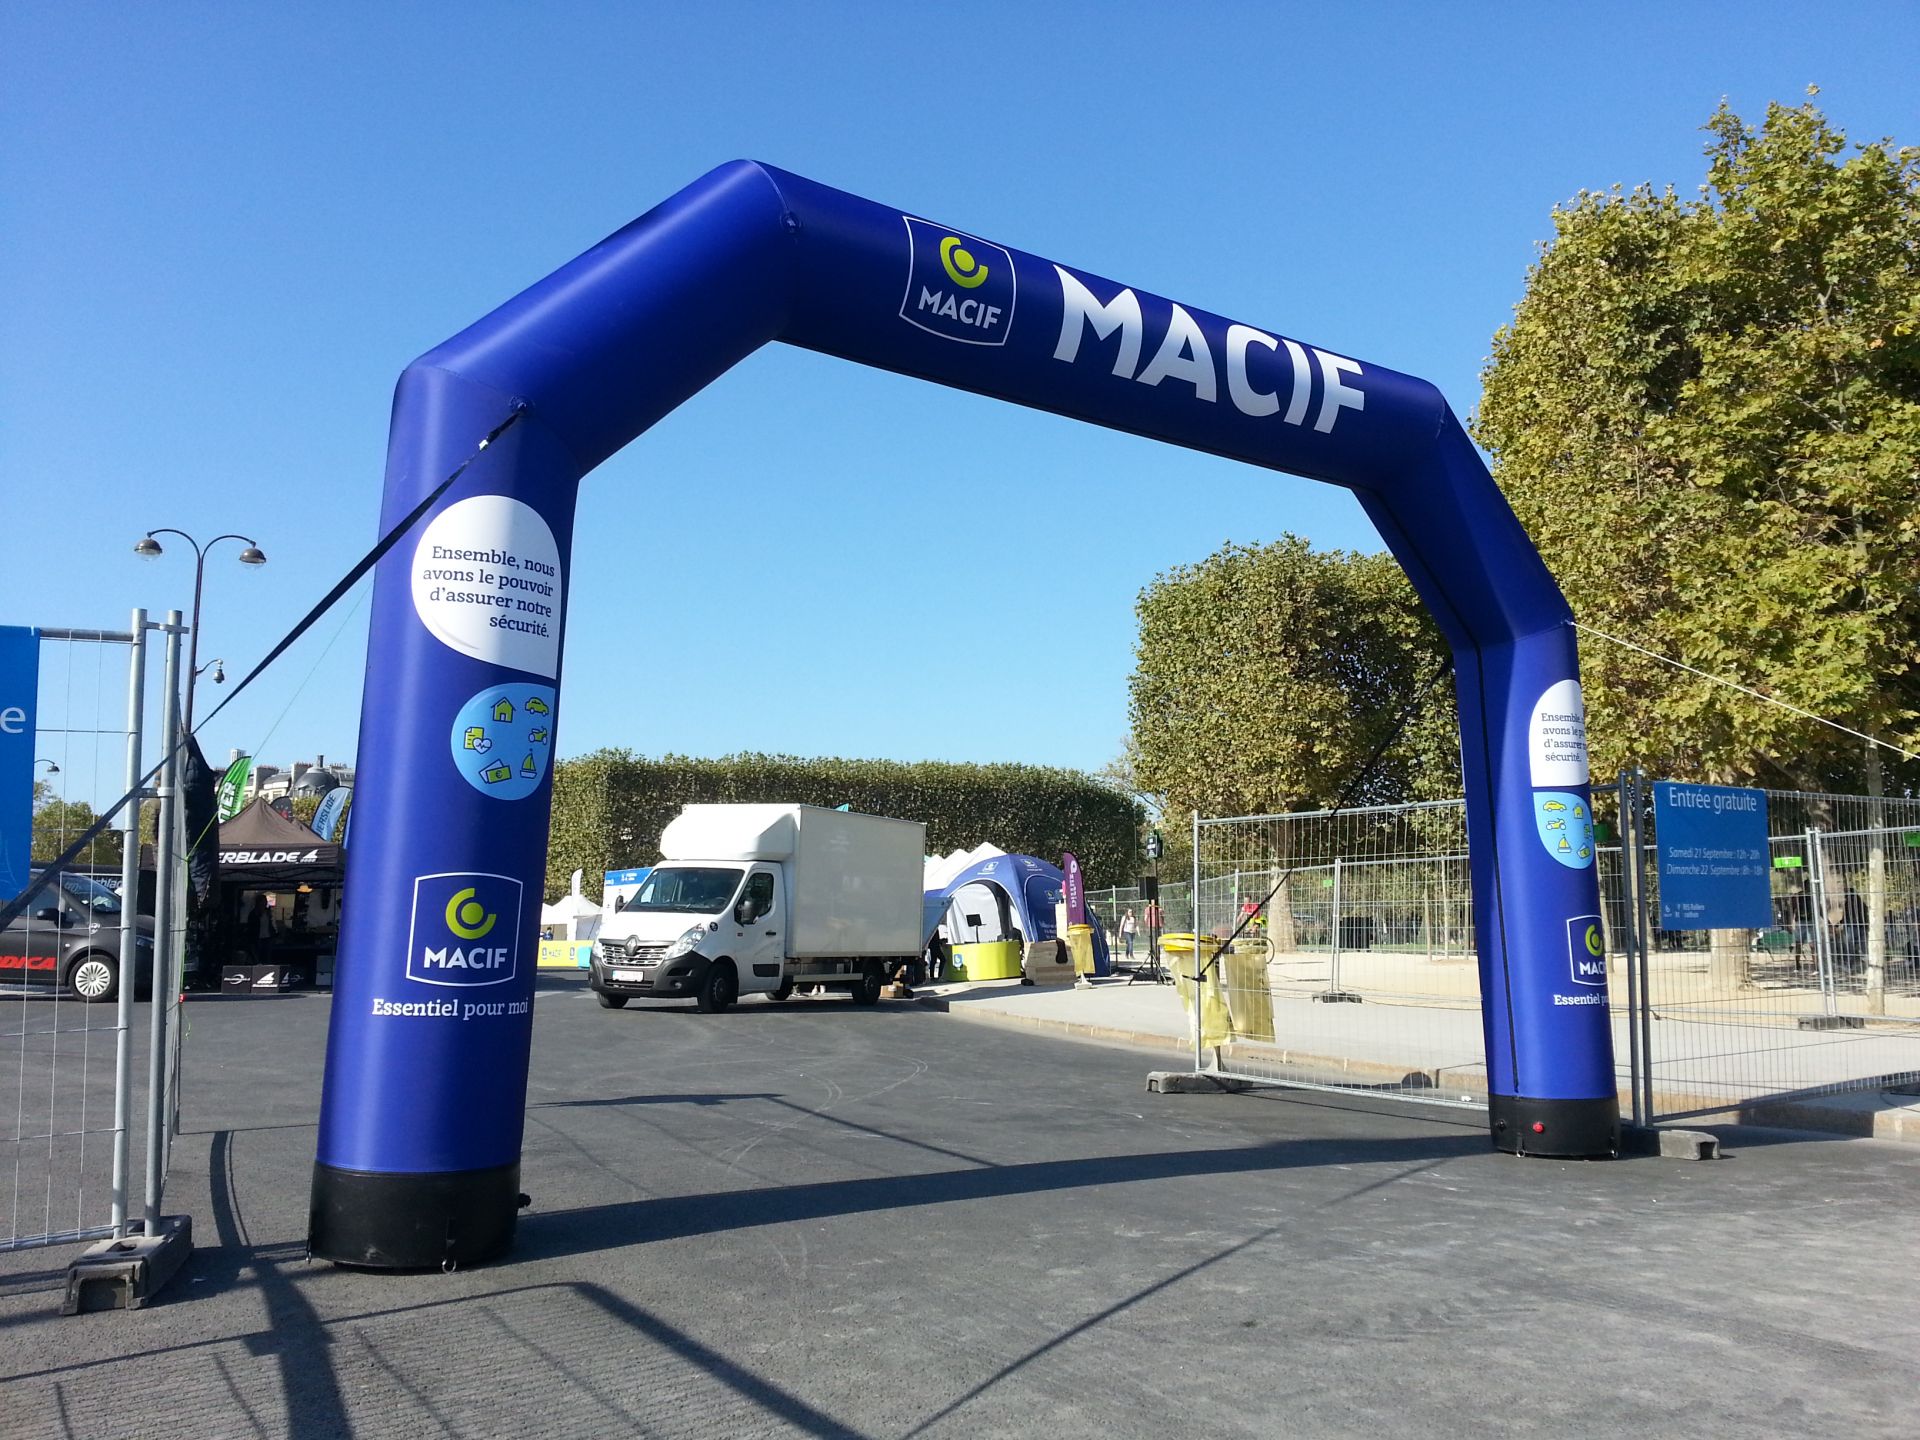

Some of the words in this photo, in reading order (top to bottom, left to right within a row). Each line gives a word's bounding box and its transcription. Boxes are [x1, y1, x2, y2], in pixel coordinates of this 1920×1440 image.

[918, 285, 1002, 329] MACIF
[1053, 264, 1365, 434] MACIF
[432, 545, 520, 569] Ensemble,
[524, 558, 555, 577] nous
[423, 567, 474, 583] avons
[479, 569, 494, 584] le
[498, 574, 554, 597] pouvoir
[429, 587, 513, 609] d'assurer
[516, 599, 552, 618] notre
[489, 615, 550, 638] sécurité.
[1543, 727, 1571, 736] avons
[1669, 787, 1711, 809] Entrée
[1714, 792, 1757, 815] gratuite
[1668, 847, 1694, 858] Samedi
[1694, 848, 1702, 858] 21
[1666, 863, 1701, 875] Dimanche
[423, 946, 508, 969] MACIF
[372, 998, 458, 1017] Essentiel
[463, 1001, 506, 1021] pour
[508, 997, 529, 1014] moi
[1553, 993, 1600, 1006] Essentiel
